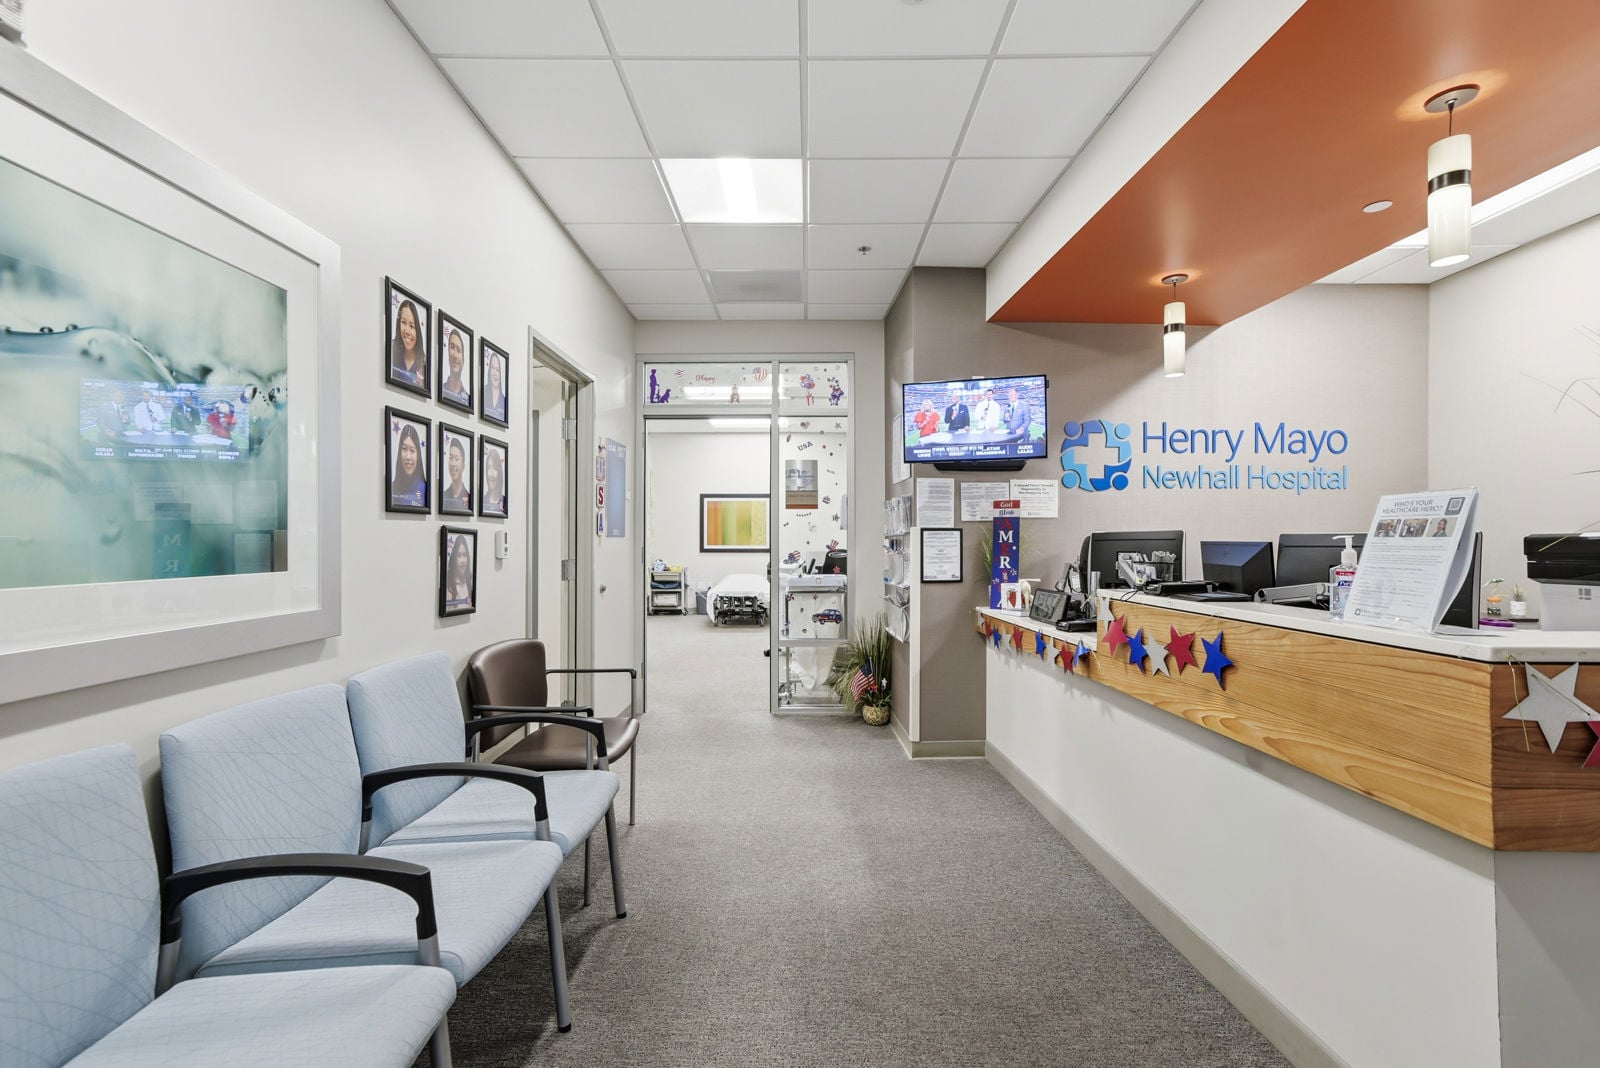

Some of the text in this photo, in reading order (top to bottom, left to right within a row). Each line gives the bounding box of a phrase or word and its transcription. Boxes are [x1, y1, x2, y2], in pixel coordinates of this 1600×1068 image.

[797, 441, 813, 452] USA
[1142, 421, 1348, 463] Henry Mayo
[1142, 465, 1348, 495] Newhall Hospital
[996, 517, 1014, 607] AMERI
